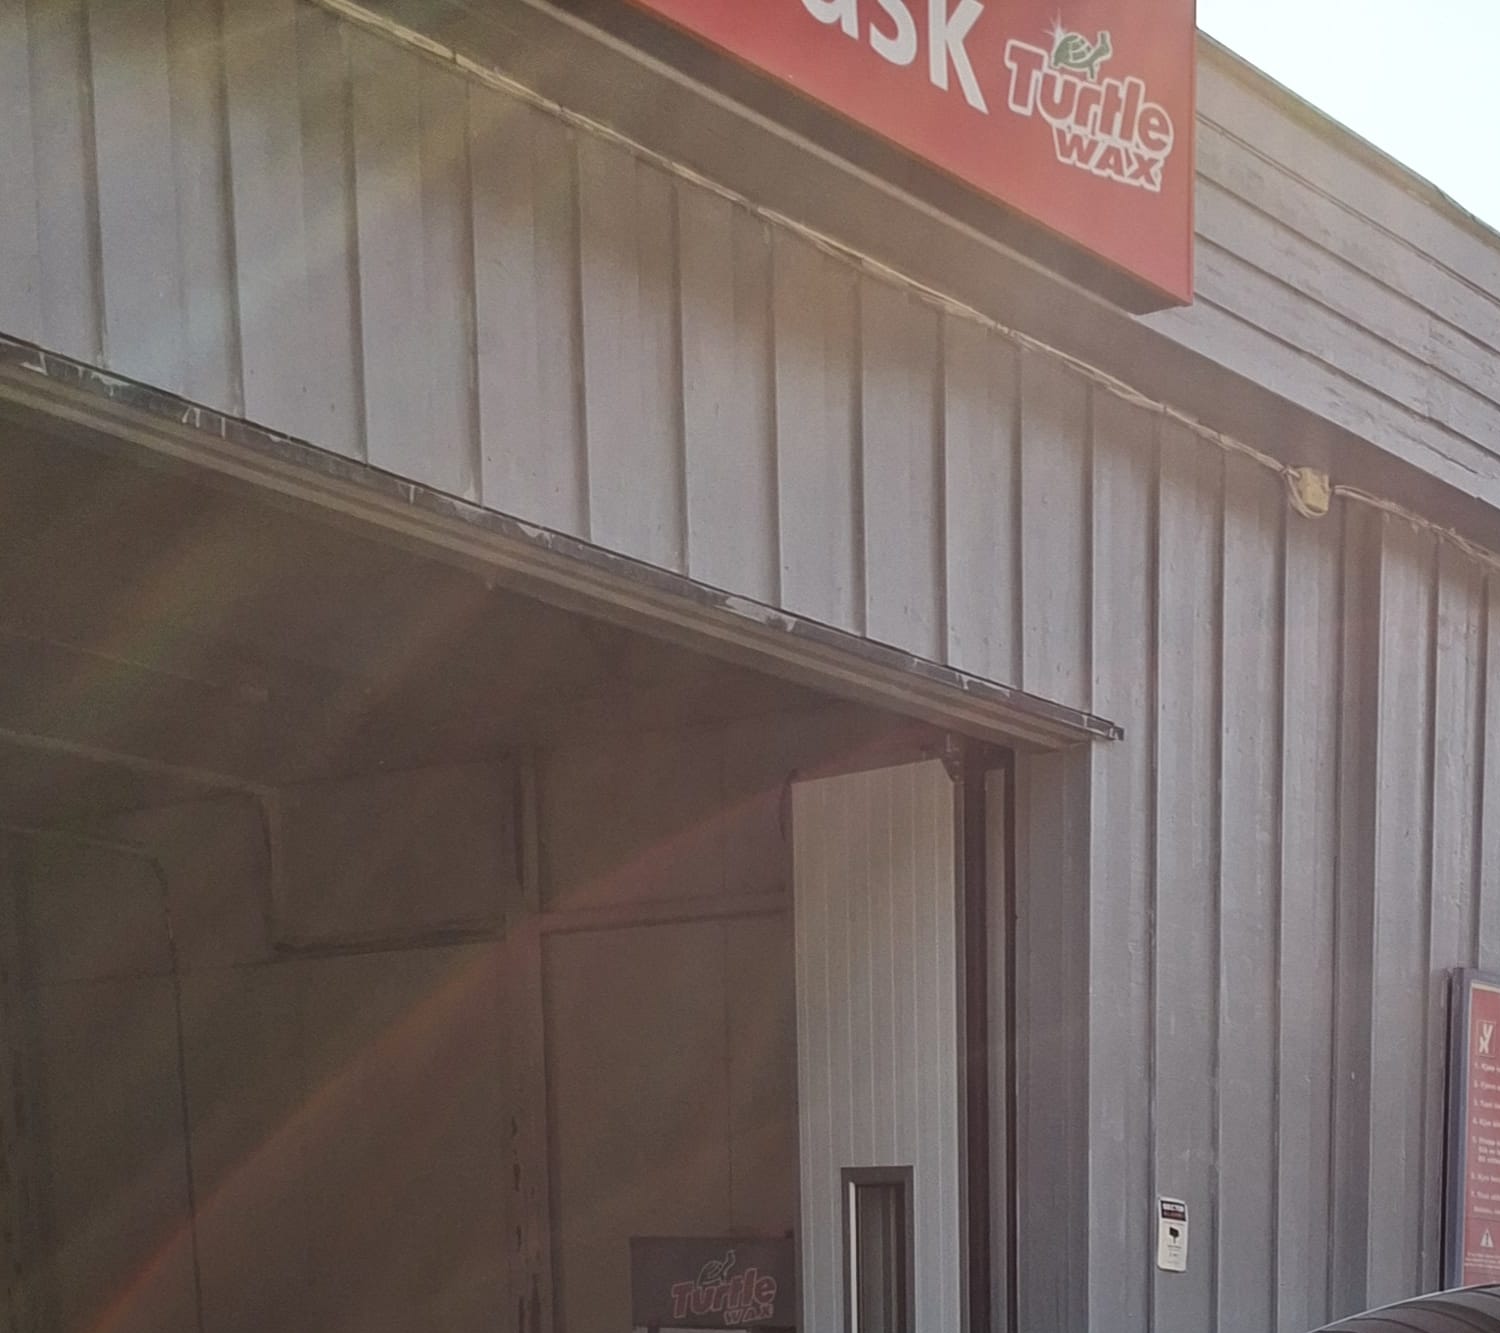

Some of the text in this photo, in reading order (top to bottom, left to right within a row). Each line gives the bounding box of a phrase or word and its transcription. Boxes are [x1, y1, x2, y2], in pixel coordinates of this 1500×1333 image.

[1004, 40, 1174, 156] Turtle
[1054, 125, 1162, 191] WAX
[671, 1268, 777, 1319] Turtle
[723, 1303, 775, 1326] WAX
